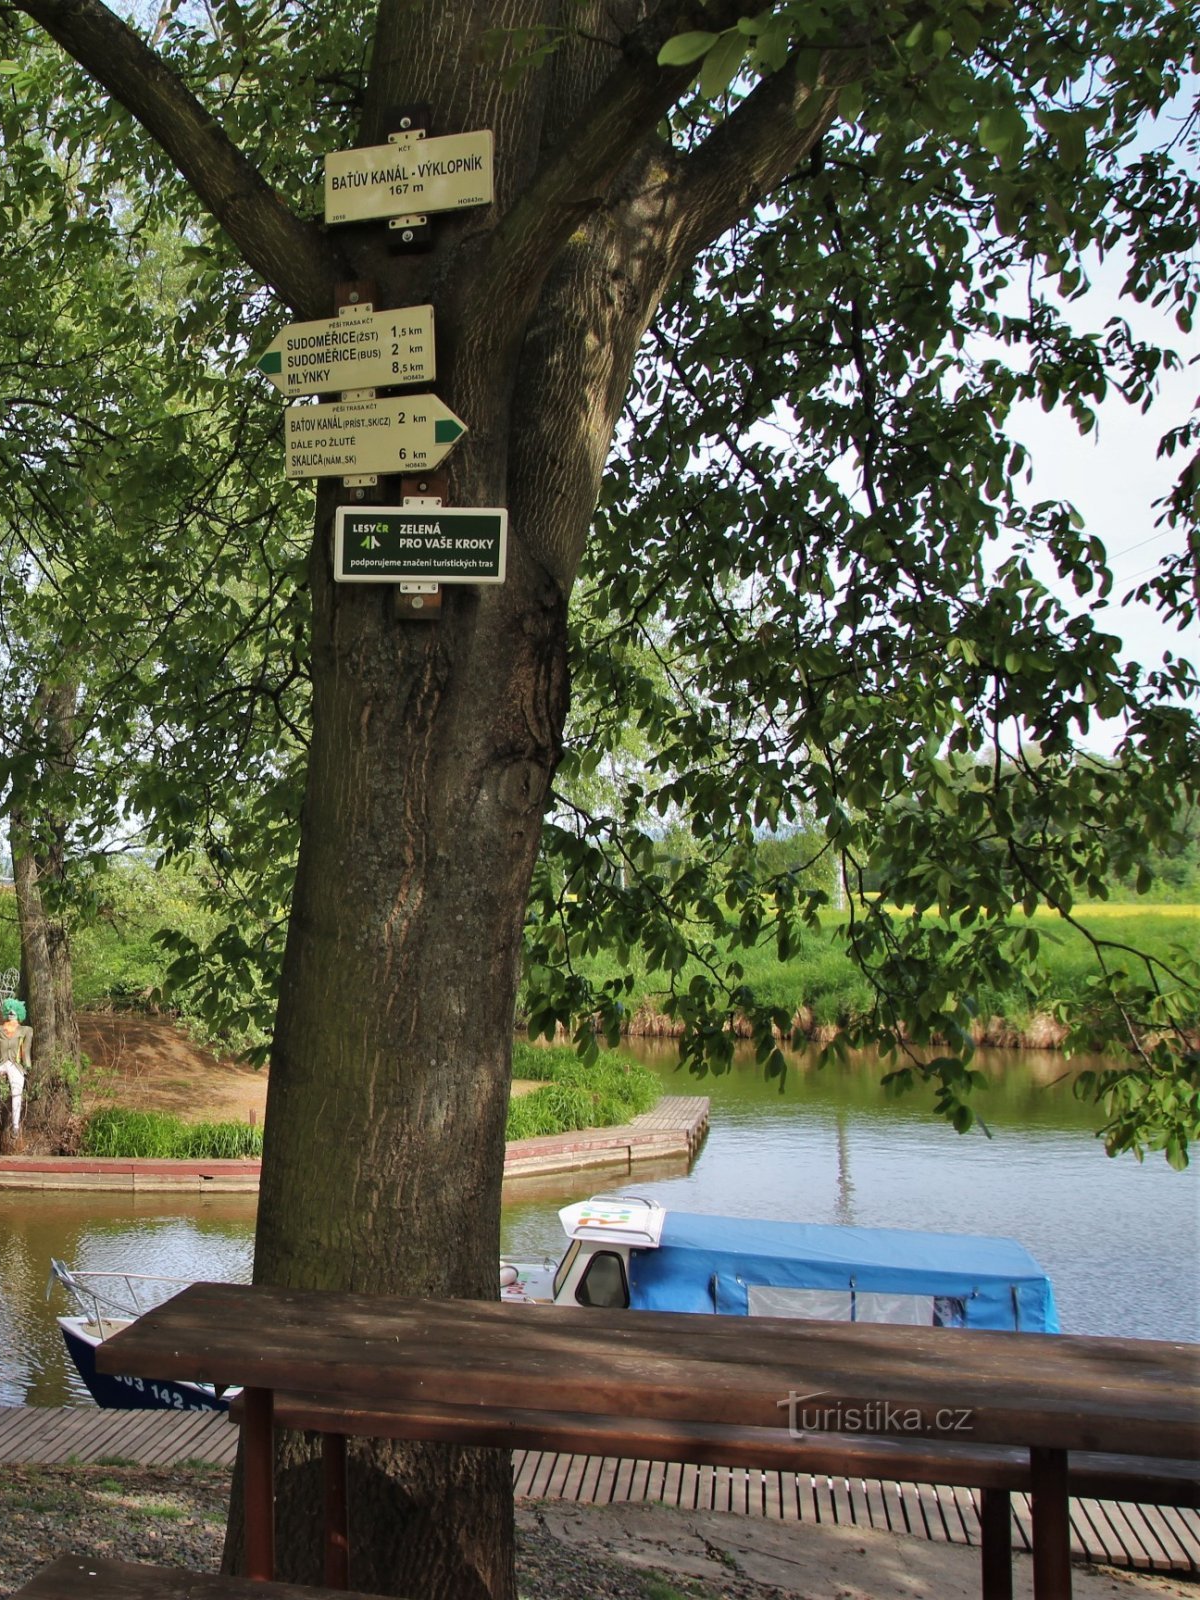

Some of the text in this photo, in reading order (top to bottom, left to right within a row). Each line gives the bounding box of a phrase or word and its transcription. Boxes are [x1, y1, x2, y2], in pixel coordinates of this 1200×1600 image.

[371, 164, 409, 185] KANÁL
[417, 154, 483, 178] VÝKLOPNÍK
[389, 183, 424, 196] 167 m
[342, 319, 361, 328] TRASA
[361, 317, 374, 325] KČT
[287, 330, 356, 351] SUDOMĚŘICE
[390, 325, 407, 339] 1,5
[409, 326, 423, 336] km
[287, 348, 357, 368] SUDOMĚŘICE
[391, 343, 399, 356] 2
[409, 345, 423, 354] km
[287, 361, 424, 386] MLÝNKY 8,5 km
[346, 404, 365, 412] TRASA
[317, 413, 343, 431] KANÁL
[398, 411, 406, 425] 2
[413, 414, 427, 424] km
[291, 435, 356, 450] DÁLE PO ŽLUTÉ
[291, 452, 323, 468] SKALICA
[399, 448, 407, 460] 6
[413, 450, 427, 459] km
[400, 521, 442, 535] ZELENÁ
[400, 535, 494, 549] PRO VAŠE KROKY
[350, 558, 494, 569] podporujeme značení turistických tras
[151, 1384, 184, 1409] 142
